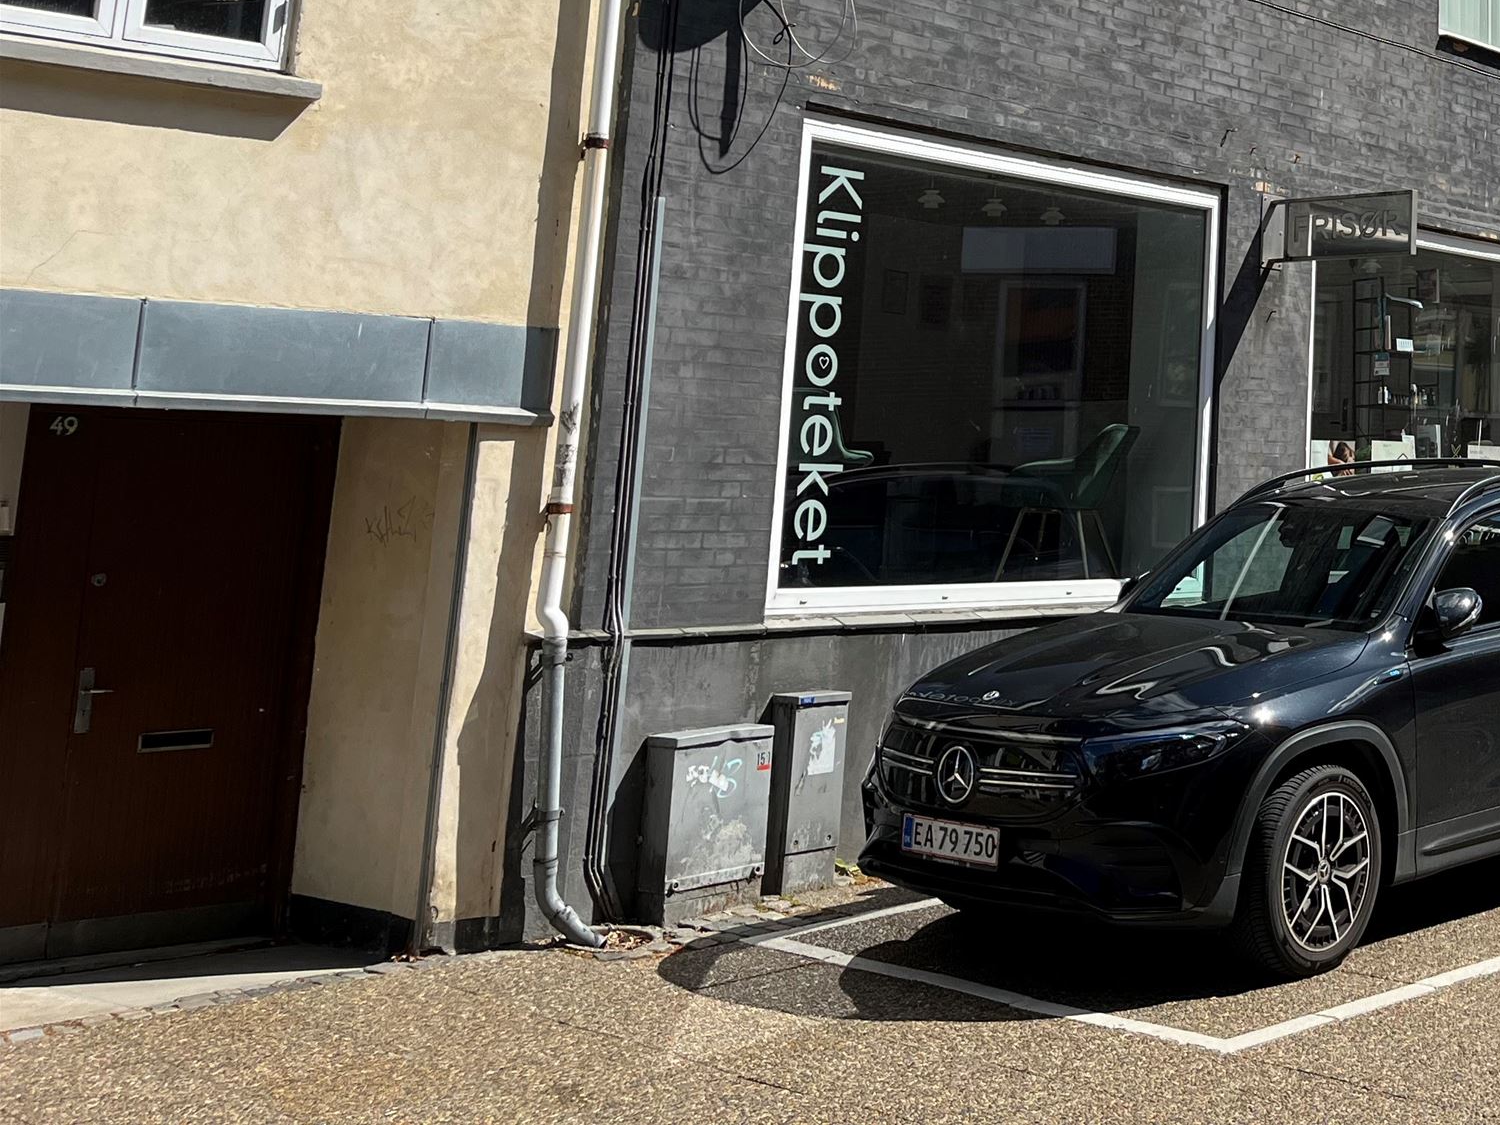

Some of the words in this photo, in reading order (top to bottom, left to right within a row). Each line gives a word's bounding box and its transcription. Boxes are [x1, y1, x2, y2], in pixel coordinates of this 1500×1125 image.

[1293, 209, 1401, 243] FRISØR
[791, 165, 865, 565] Klippoteket
[49, 416, 79, 436] 49
[914, 822, 934, 849] EA
[938, 826, 959, 853] 79
[963, 830, 997, 859] 750
